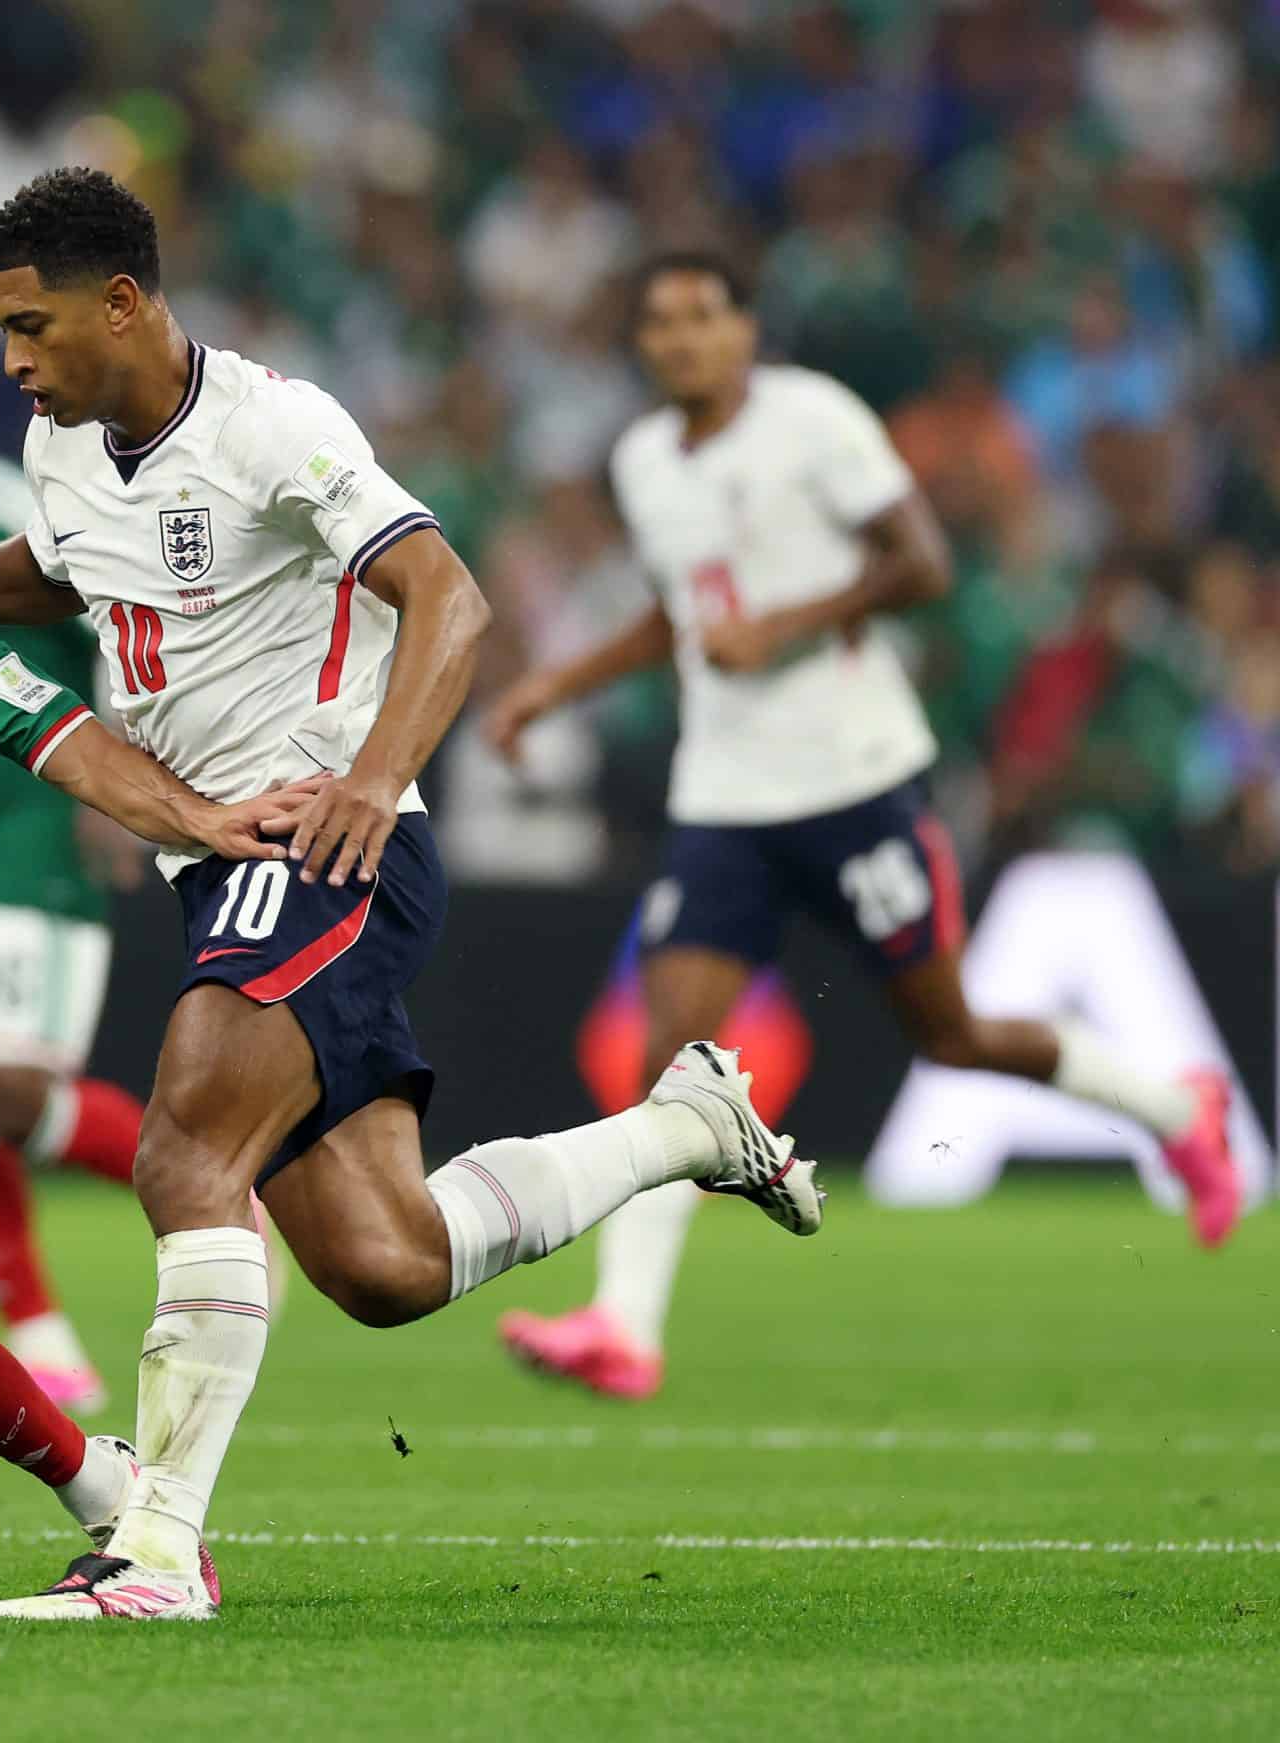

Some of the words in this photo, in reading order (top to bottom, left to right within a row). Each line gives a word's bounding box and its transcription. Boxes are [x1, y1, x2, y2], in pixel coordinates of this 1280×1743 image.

[177, 586, 215, 598] MEXICO
[109, 602, 167, 694] 10
[208, 860, 290, 940] 10
[860, 850, 1280, 1213] A
